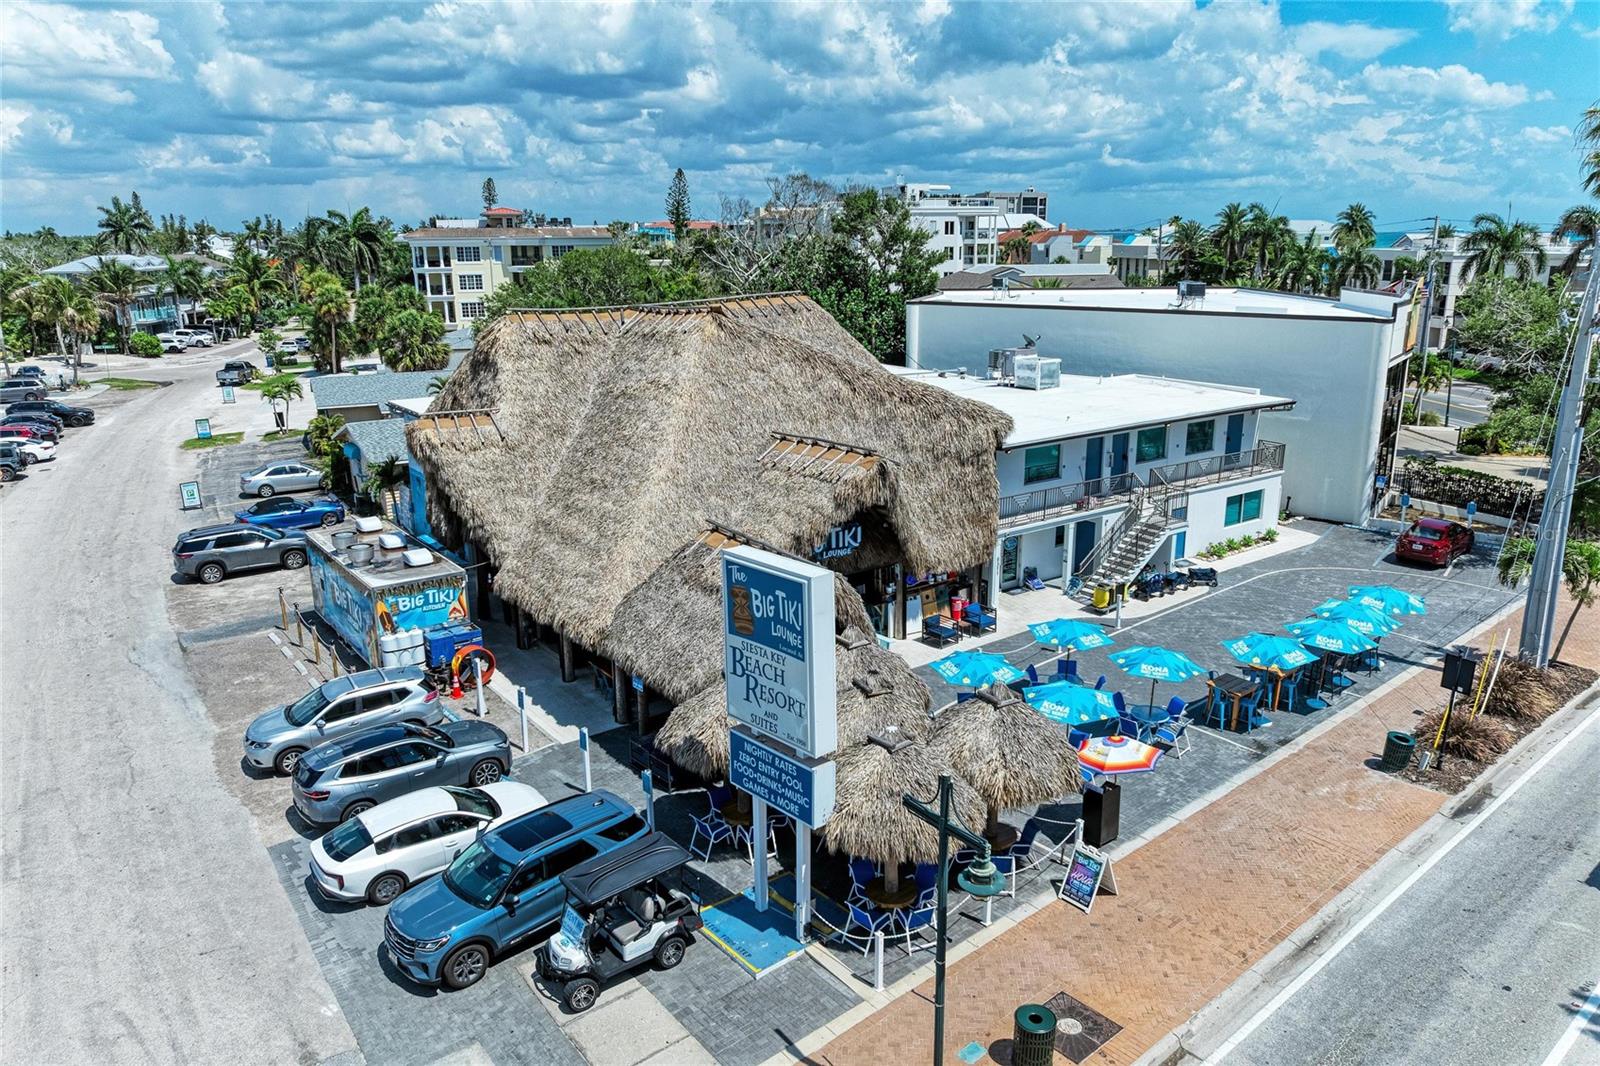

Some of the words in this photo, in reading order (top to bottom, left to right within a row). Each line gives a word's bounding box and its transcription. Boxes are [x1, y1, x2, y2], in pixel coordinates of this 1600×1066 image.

[831, 526, 862, 549] TIKI
[823, 548, 853, 559] LOUNGE
[728, 565, 748, 583] The
[398, 595, 424, 612] BIG
[426, 589, 454, 604] TIKI
[750, 587, 775, 618] BIG
[775, 590, 802, 631] TIKI
[771, 621, 802, 648] LOUNGE
[1348, 619, 1374, 629] KONA
[1317, 635, 1343, 646] KONA
[741, 641, 768, 660] SIESTA
[771, 651, 787, 667] KEY
[730, 645, 786, 687] BEACH
[1141, 664, 1169, 673] KONA
[743, 673, 806, 719] RESORT
[1042, 700, 1070, 713] KONA
[750, 713, 778, 734] SUITES
[764, 710, 779, 721] AND
[744, 741, 773, 763] NIGHTLY
[775, 758, 797, 776] RATES
[739, 751, 756, 767] ZERO
[758, 761, 780, 779] ENTRY
[781, 773, 803, 793] POOL
[742, 777, 769, 799] GAMES
[777, 798, 800, 815] MORE
[1071, 871, 1094, 887] HOUR
